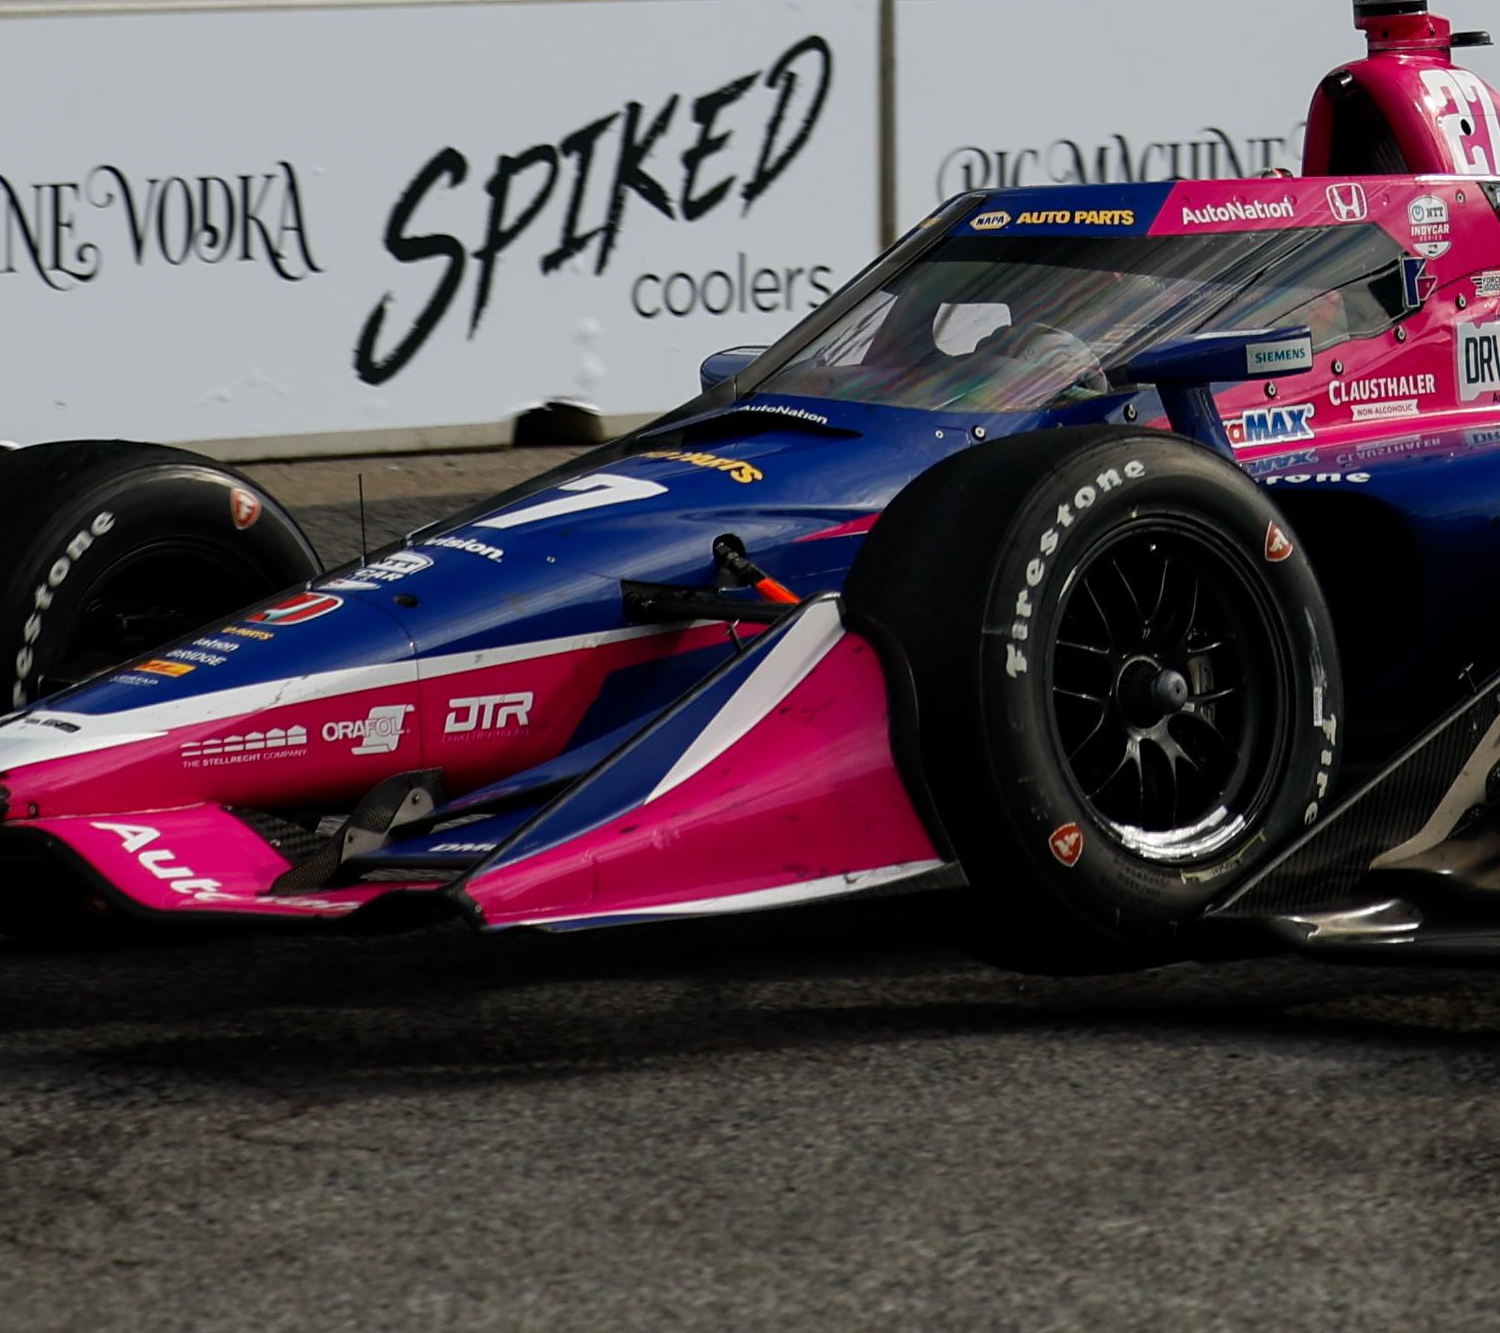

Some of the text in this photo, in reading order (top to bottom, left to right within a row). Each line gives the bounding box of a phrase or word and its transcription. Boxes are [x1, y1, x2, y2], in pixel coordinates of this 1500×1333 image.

[90, 160, 325, 281] VODKA
[353, 35, 833, 386] SPIKED
[974, 210, 1135, 227] NAPA AUTO PARTS
[1182, 198, 1295, 225] AutoNation
[1426, 206, 1444, 218] NTT
[1411, 223, 1450, 237] INDYCAR
[632, 252, 834, 319] coolers
[1255, 347, 1306, 363] SIEMENS
[1329, 373, 1437, 407] CLAUSTHALER
[741, 403, 829, 425] AutoNation
[1357, 403, 1414, 417] NON-ALCOHOLIC
[1006, 459, 1146, 678] Firestone
[444, 691, 535, 734] DTR
[322, 717, 404, 743] ORAFOL
[183, 749, 307, 769] THE STELLRECHT COMPANY
